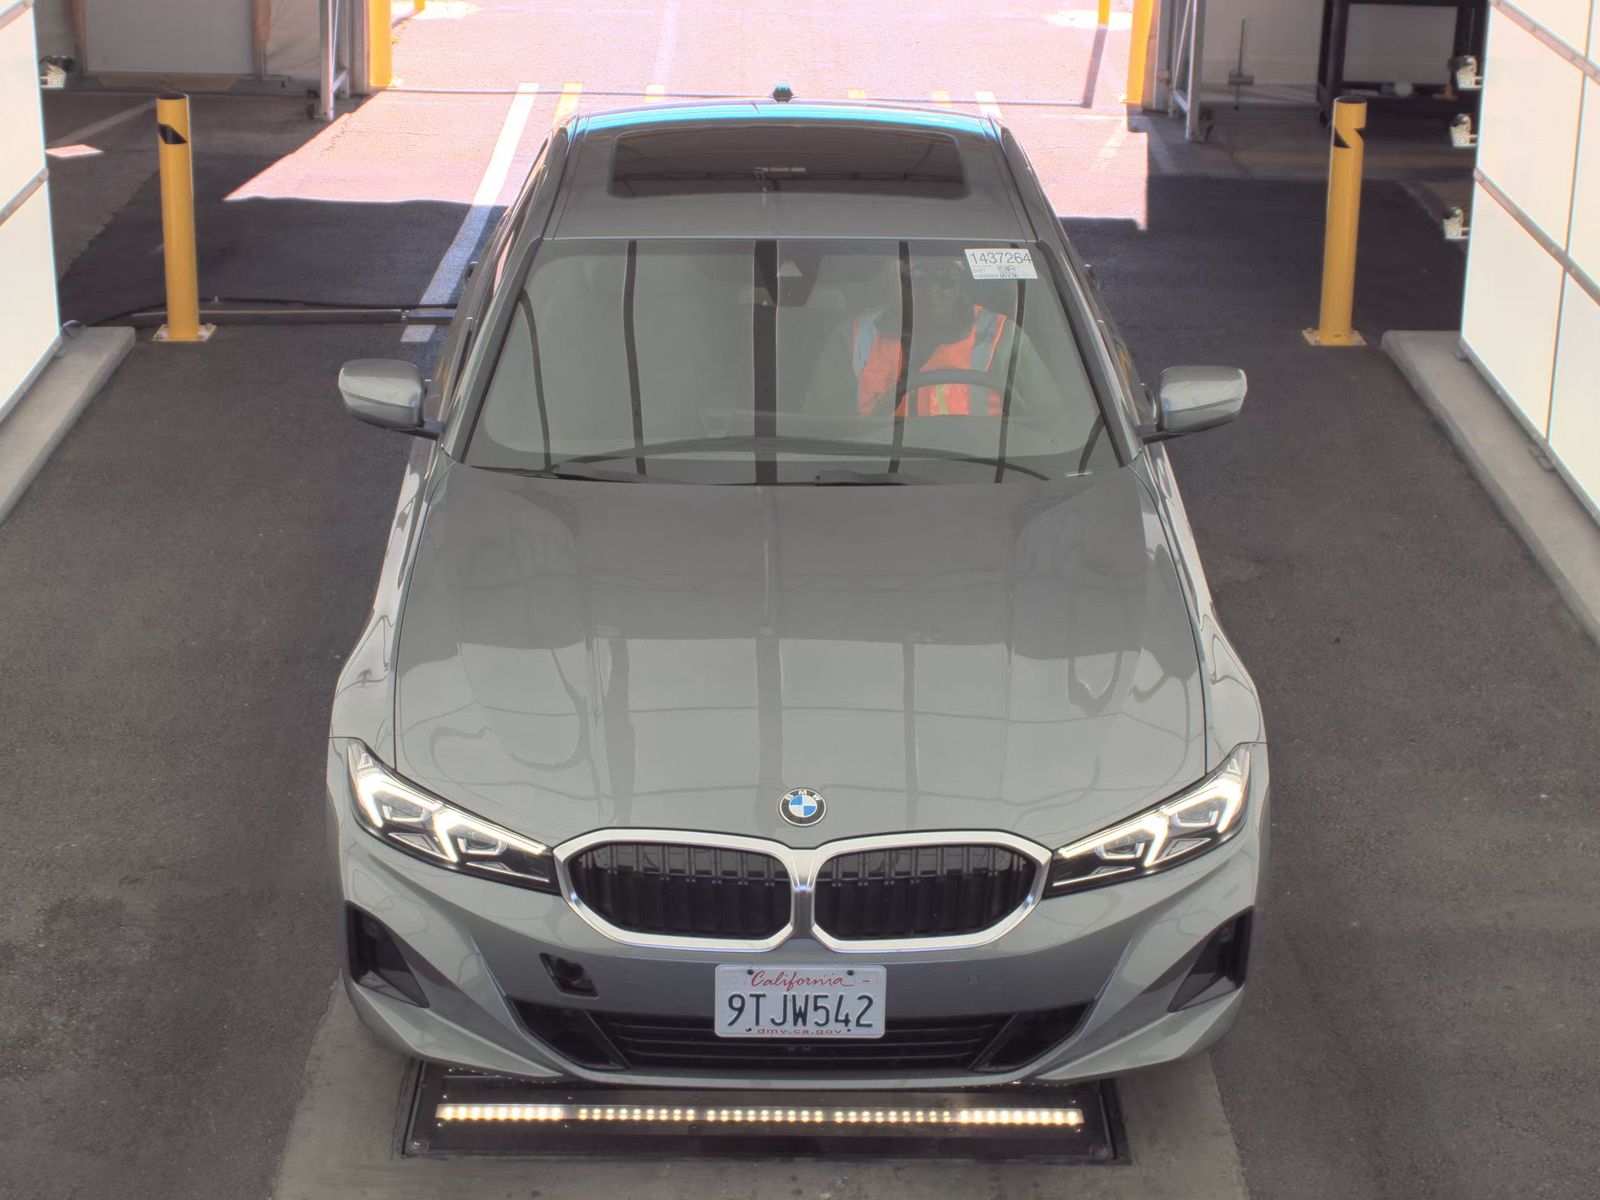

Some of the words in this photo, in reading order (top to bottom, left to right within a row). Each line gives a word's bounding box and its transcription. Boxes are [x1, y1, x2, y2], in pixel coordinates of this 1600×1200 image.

[970, 252, 1032, 264] 1437264
[751, 970, 855, 991] California
[727, 993, 874, 1028] 9TJW542
